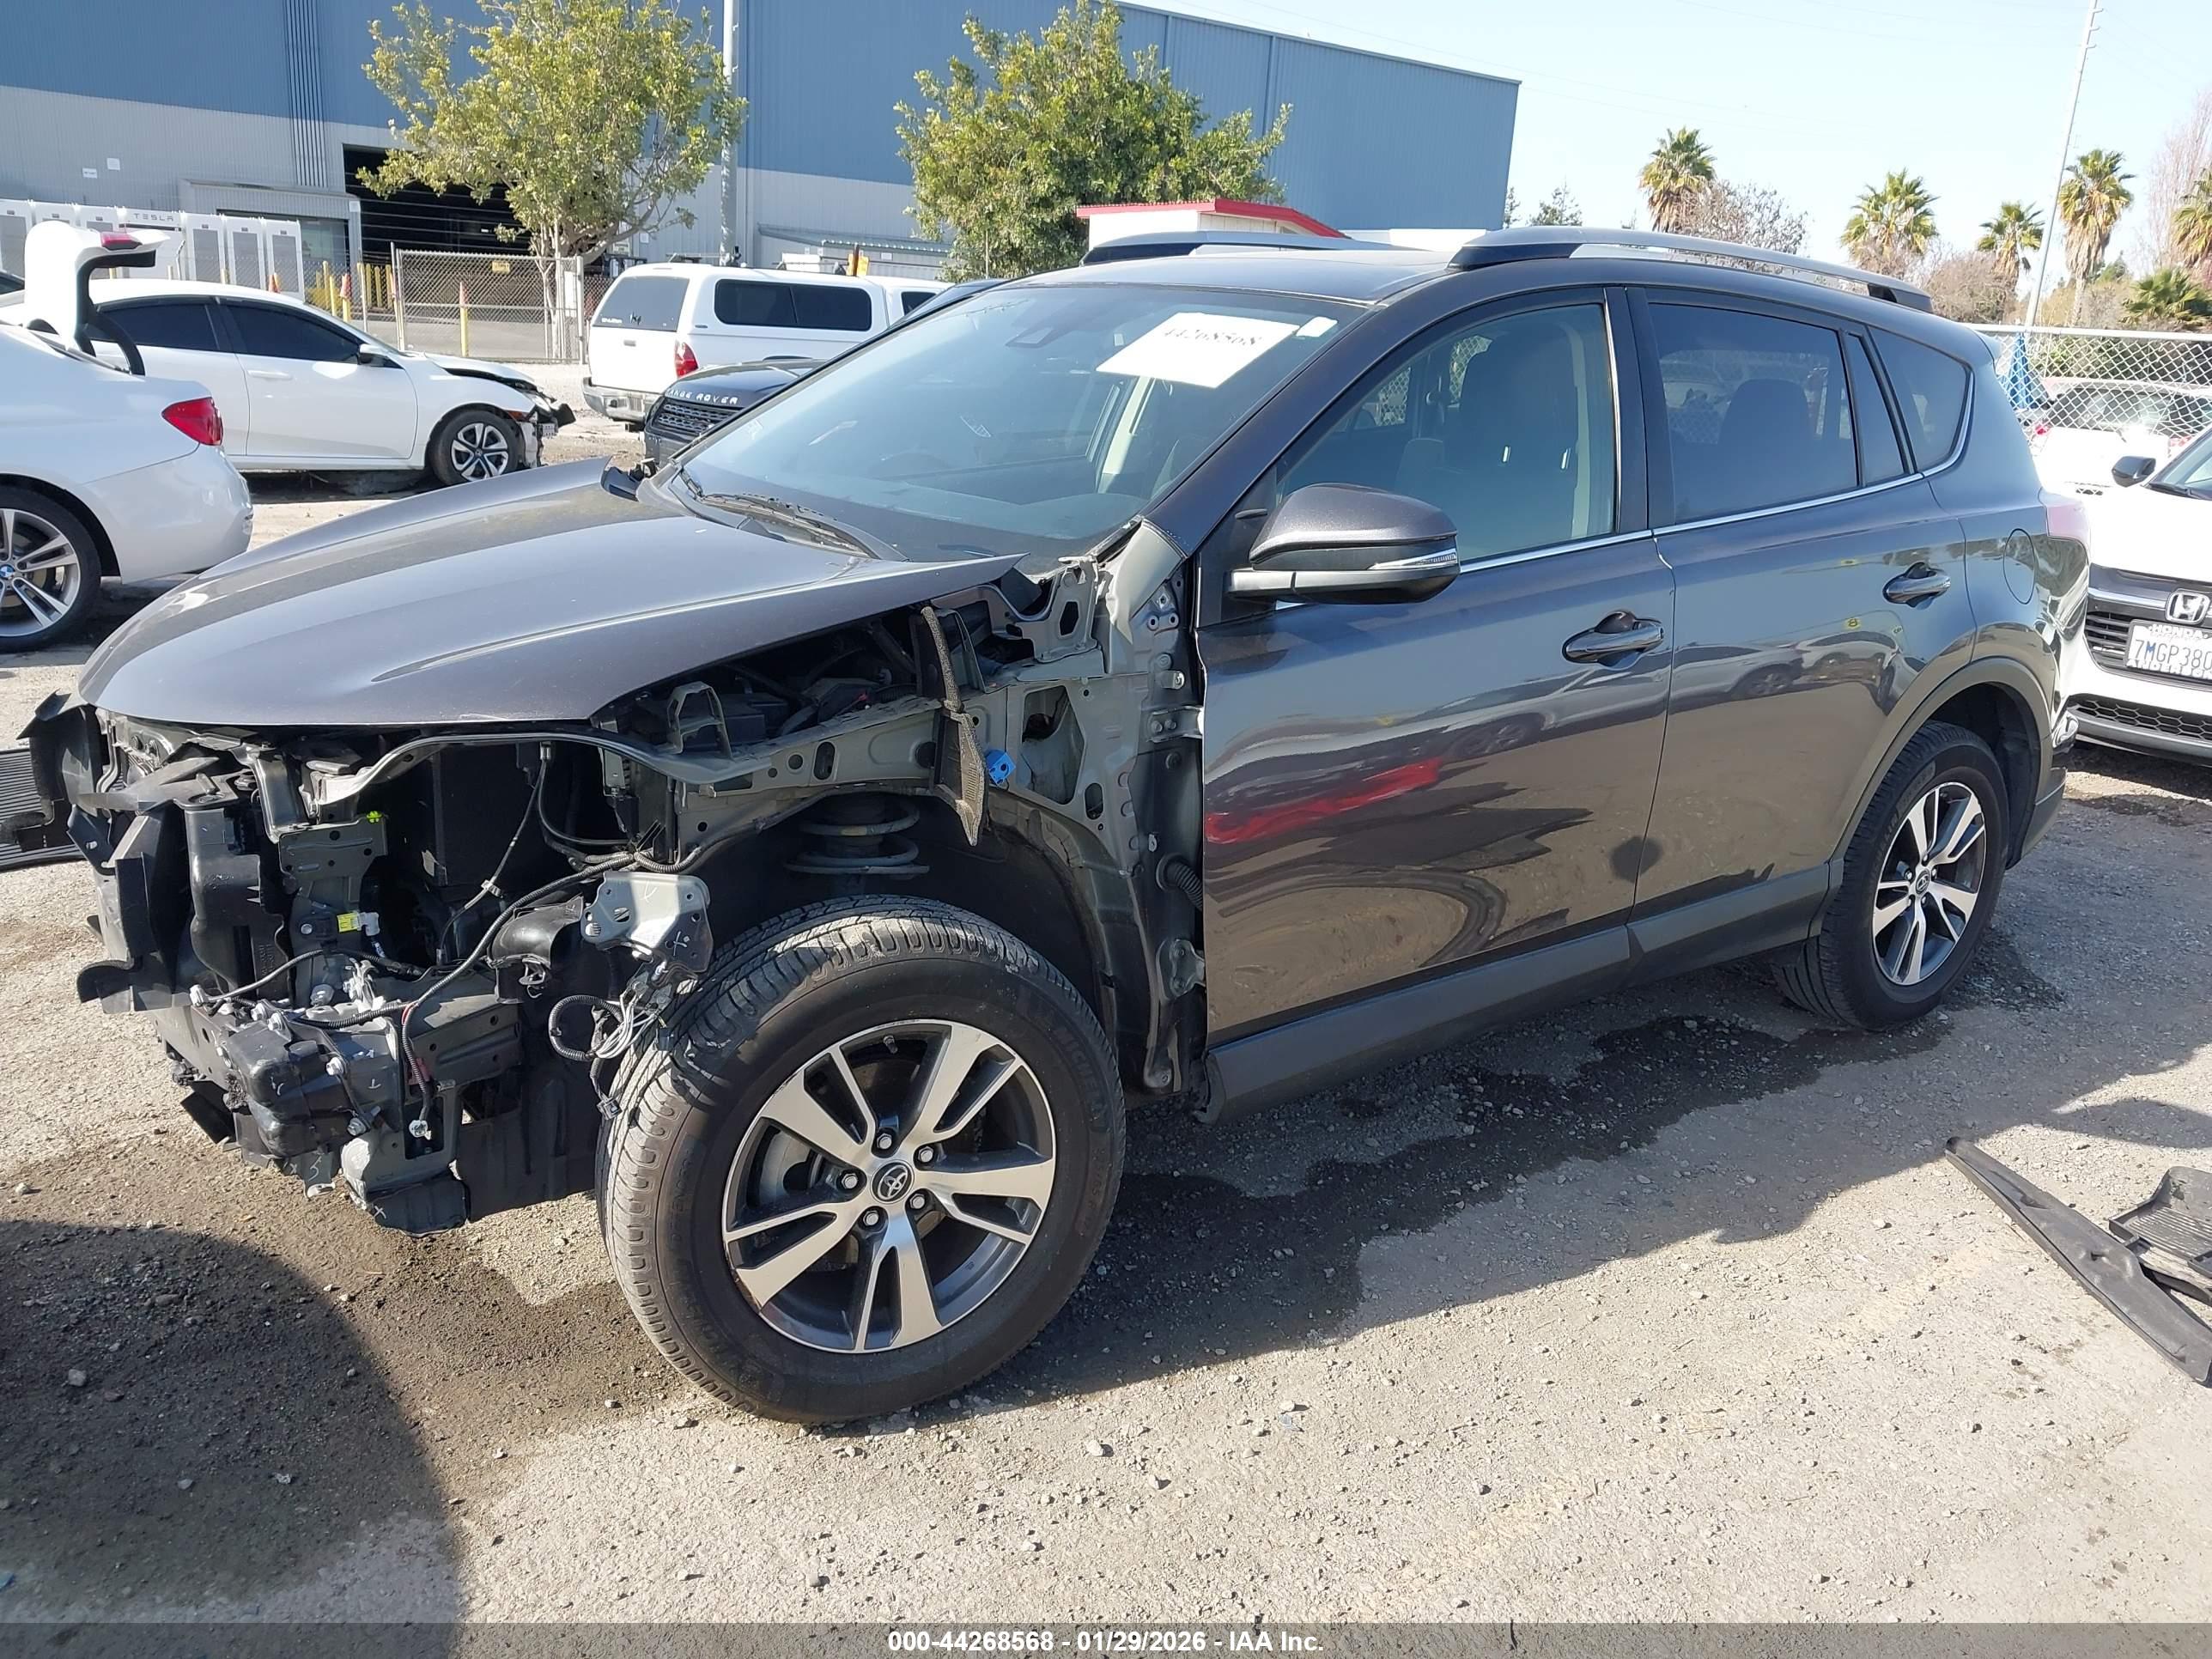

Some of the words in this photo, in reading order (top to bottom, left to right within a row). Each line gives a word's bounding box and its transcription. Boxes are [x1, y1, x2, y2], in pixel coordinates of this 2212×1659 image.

[133, 212, 174, 222] TESLA
[696, 393, 738, 404] ROVER
[2152, 623, 2203, 638] HONDA
[2135, 638, 2212, 671] 7MGP380
